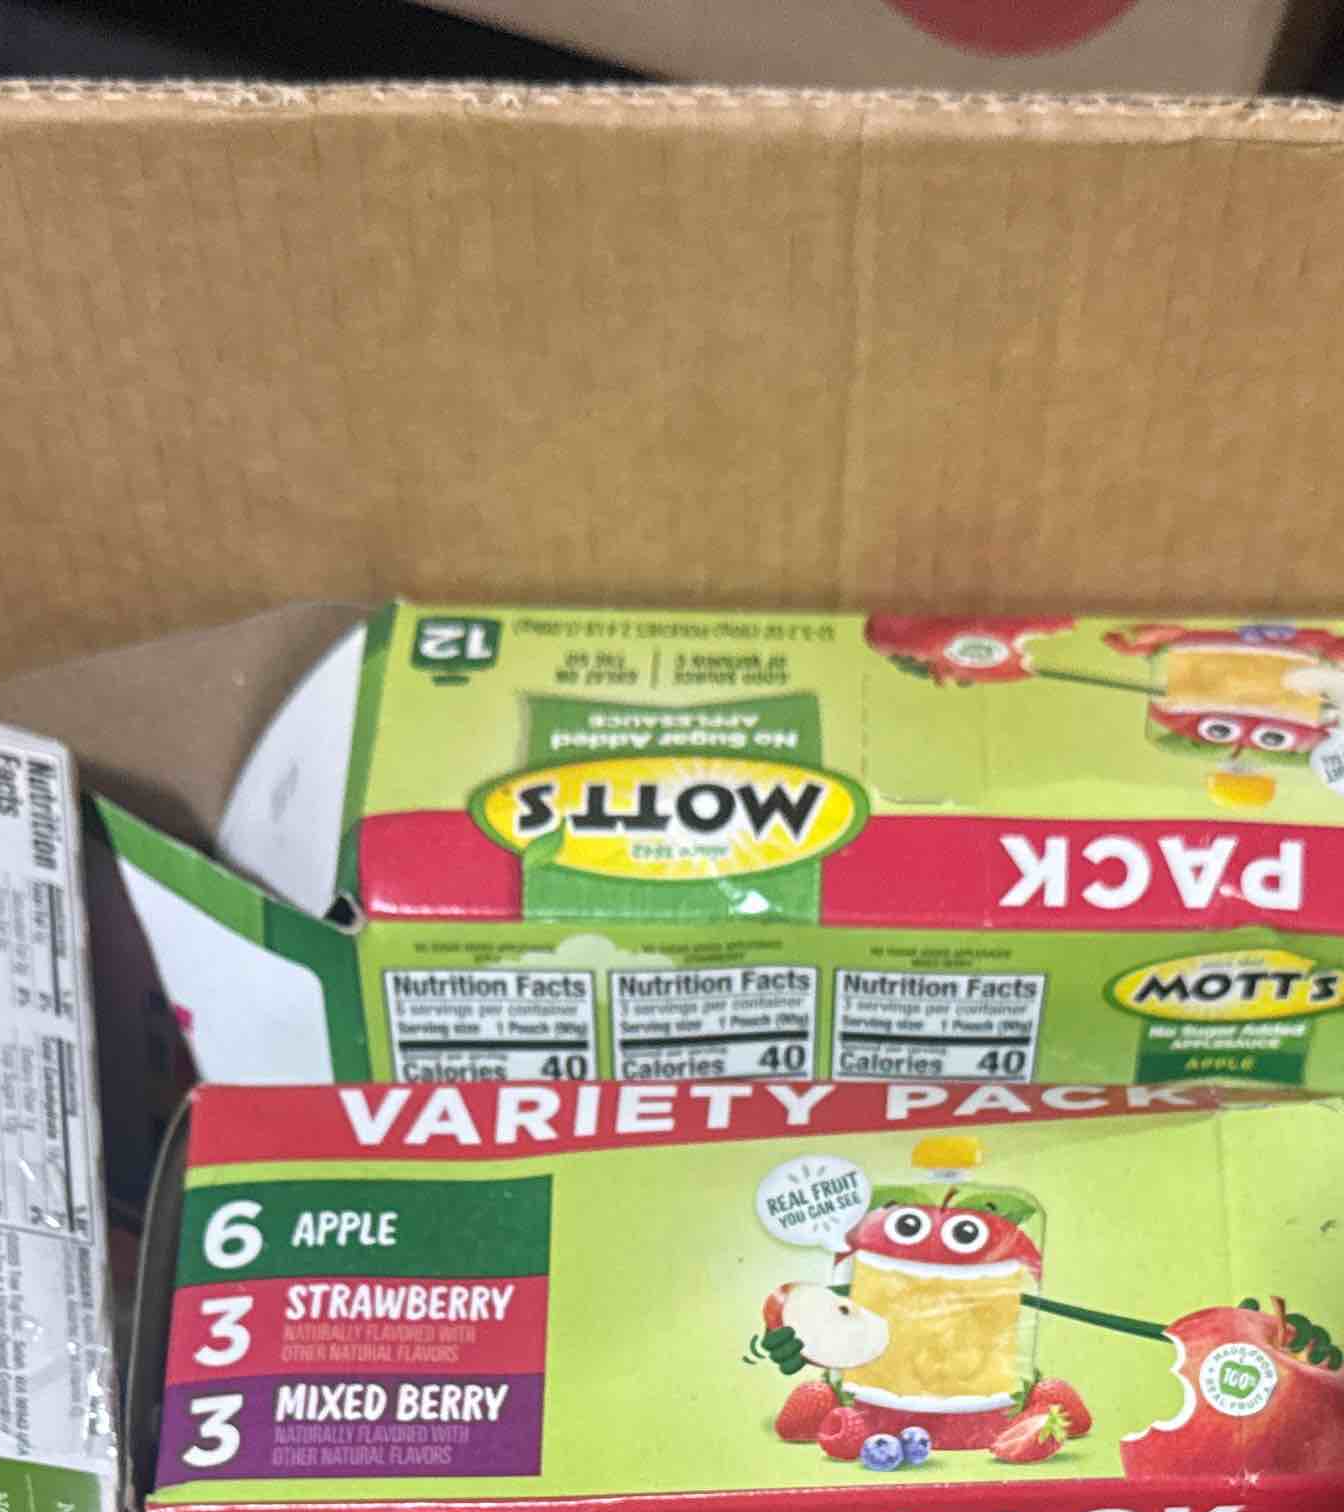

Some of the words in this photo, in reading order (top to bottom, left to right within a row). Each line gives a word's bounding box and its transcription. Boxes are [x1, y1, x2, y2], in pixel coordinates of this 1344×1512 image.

[420, 622, 492, 660] 12
[551, 729, 650, 750] Added
[658, 726, 747, 750] Sugar
[754, 730, 799, 750] No
[25, 760, 59, 869] Nutrition
[999, 834, 1305, 911] PACK
[393, 974, 507, 998] Nutrition
[515, 975, 586, 998] Facts
[618, 972, 735, 998] Nutrition
[740, 971, 811, 994] Facts
[843, 974, 958, 998] Nutrition
[966, 977, 1038, 1000] Facts
[1133, 970, 1339, 1004] MOTT'S
[622, 1055, 726, 1079] Calories
[757, 1044, 807, 1072] 40
[839, 1054, 944, 1077] Calories
[977, 1049, 1027, 1075] 40
[339, 1084, 823, 1146] VARIETY
[885, 1083, 1202, 1122] PACK
[202, 1200, 264, 1270] 6
[291, 1210, 398, 1248] APPLE
[192, 1295, 254, 1368] 3
[285, 1283, 514, 1322] STRAWBERRY
[181, 1392, 244, 1469] 3
[275, 1384, 387, 1423] MIXED
[396, 1383, 510, 1422] BERRY
